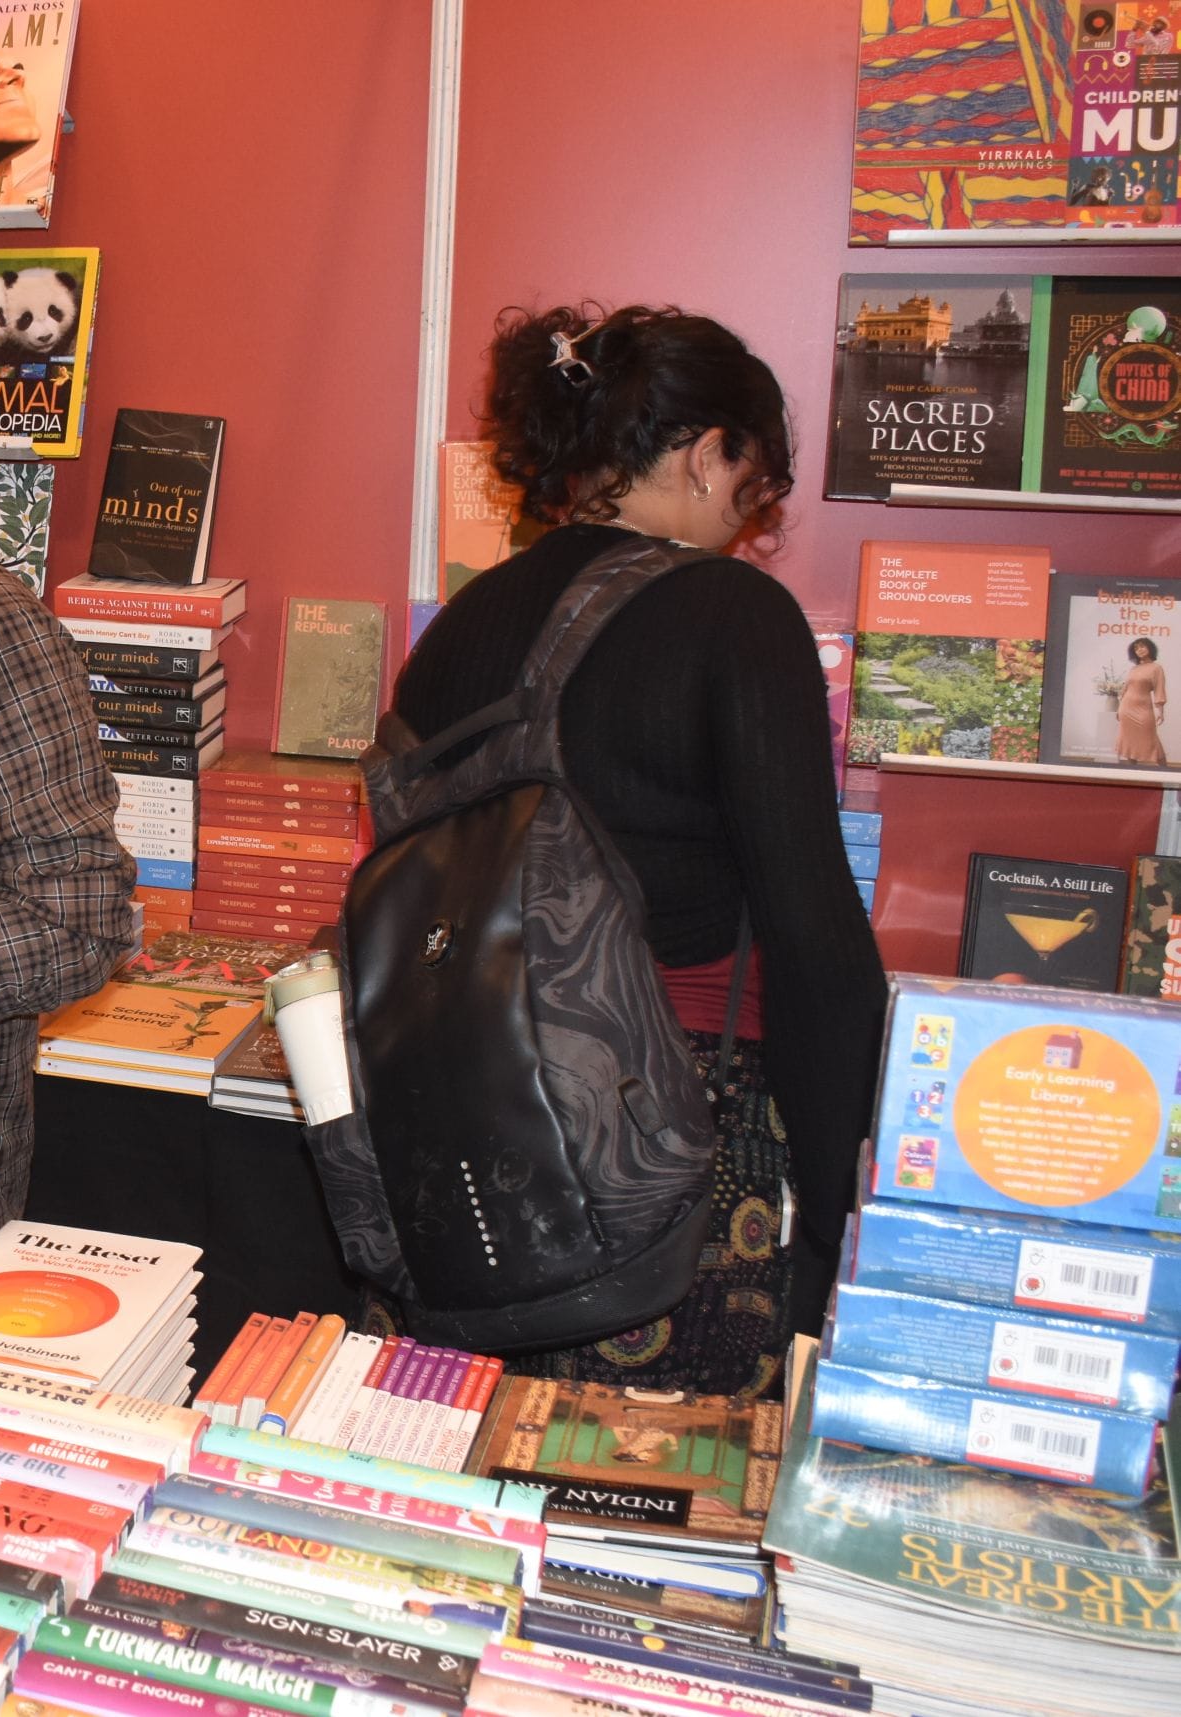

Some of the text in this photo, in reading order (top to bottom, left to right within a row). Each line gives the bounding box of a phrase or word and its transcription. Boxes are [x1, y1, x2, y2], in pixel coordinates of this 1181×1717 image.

[33, 2, 65, 11] ROSS
[979, 150, 1053, 160] YIRRKALA
[978, 161, 1053, 170] DRAWINGS
[1116, 363, 1171, 377] MYTHS OF
[1116, 379, 1170, 401] CHINA
[867, 400, 993, 426] SACRED
[871, 427, 986, 453] PLACES
[150, 482, 202, 496] Out of our
[104, 497, 198, 524] minds
[881, 558, 902, 567] THE
[880, 569, 938, 580] COMPLETE
[879, 580, 927, 590] BOOK OF
[68, 597, 104, 605] REBELS
[107, 600, 148, 609] AGAINST
[175, 604, 194, 612] RAJ
[879, 592, 971, 603] GROUND COVERS
[1097, 590, 1175, 610] building
[89, 608, 148, 617] RAMACHANDRA
[877, 617, 919, 626] Gary Lewis
[1119, 606, 1150, 621] the
[295, 622, 352, 635] REPUBLIC
[1097, 623, 1171, 638] pattern
[152, 688, 178, 696] CASEY
[328, 737, 368, 750] PLATO
[989, 870, 1114, 893] Cocktails, A Still Life
[82, 1010, 172, 1028] Gardening
[112, 1006, 180, 1020] Science
[1006, 1067, 1115, 1092] Early Learning
[1030, 1088, 1085, 1105] Library
[16, 1232, 162, 1266] The Reset
[22, 1378, 55, 1387] TO
[60, 1386, 97, 1396] AN
[341, 1411, 359, 1440] GERMAN
[437, 1429, 456, 1458] SPANISH
[22, 1457, 67, 1478] GIRL
[901, 1534, 1181, 1608] ARTISTS
[898, 1561, 1179, 1633] THE GREAT
[84, 1604, 158, 1628] DE LA CRUZ
[244, 1610, 310, 1636] SIGN
[580, 1624, 633, 1643] LIBRA
[327, 1629, 422, 1663] SLAYER
[85, 1624, 315, 1700] FORWARD MARCH
[43, 1662, 205, 1708] CAN'T GET ENOUGH
